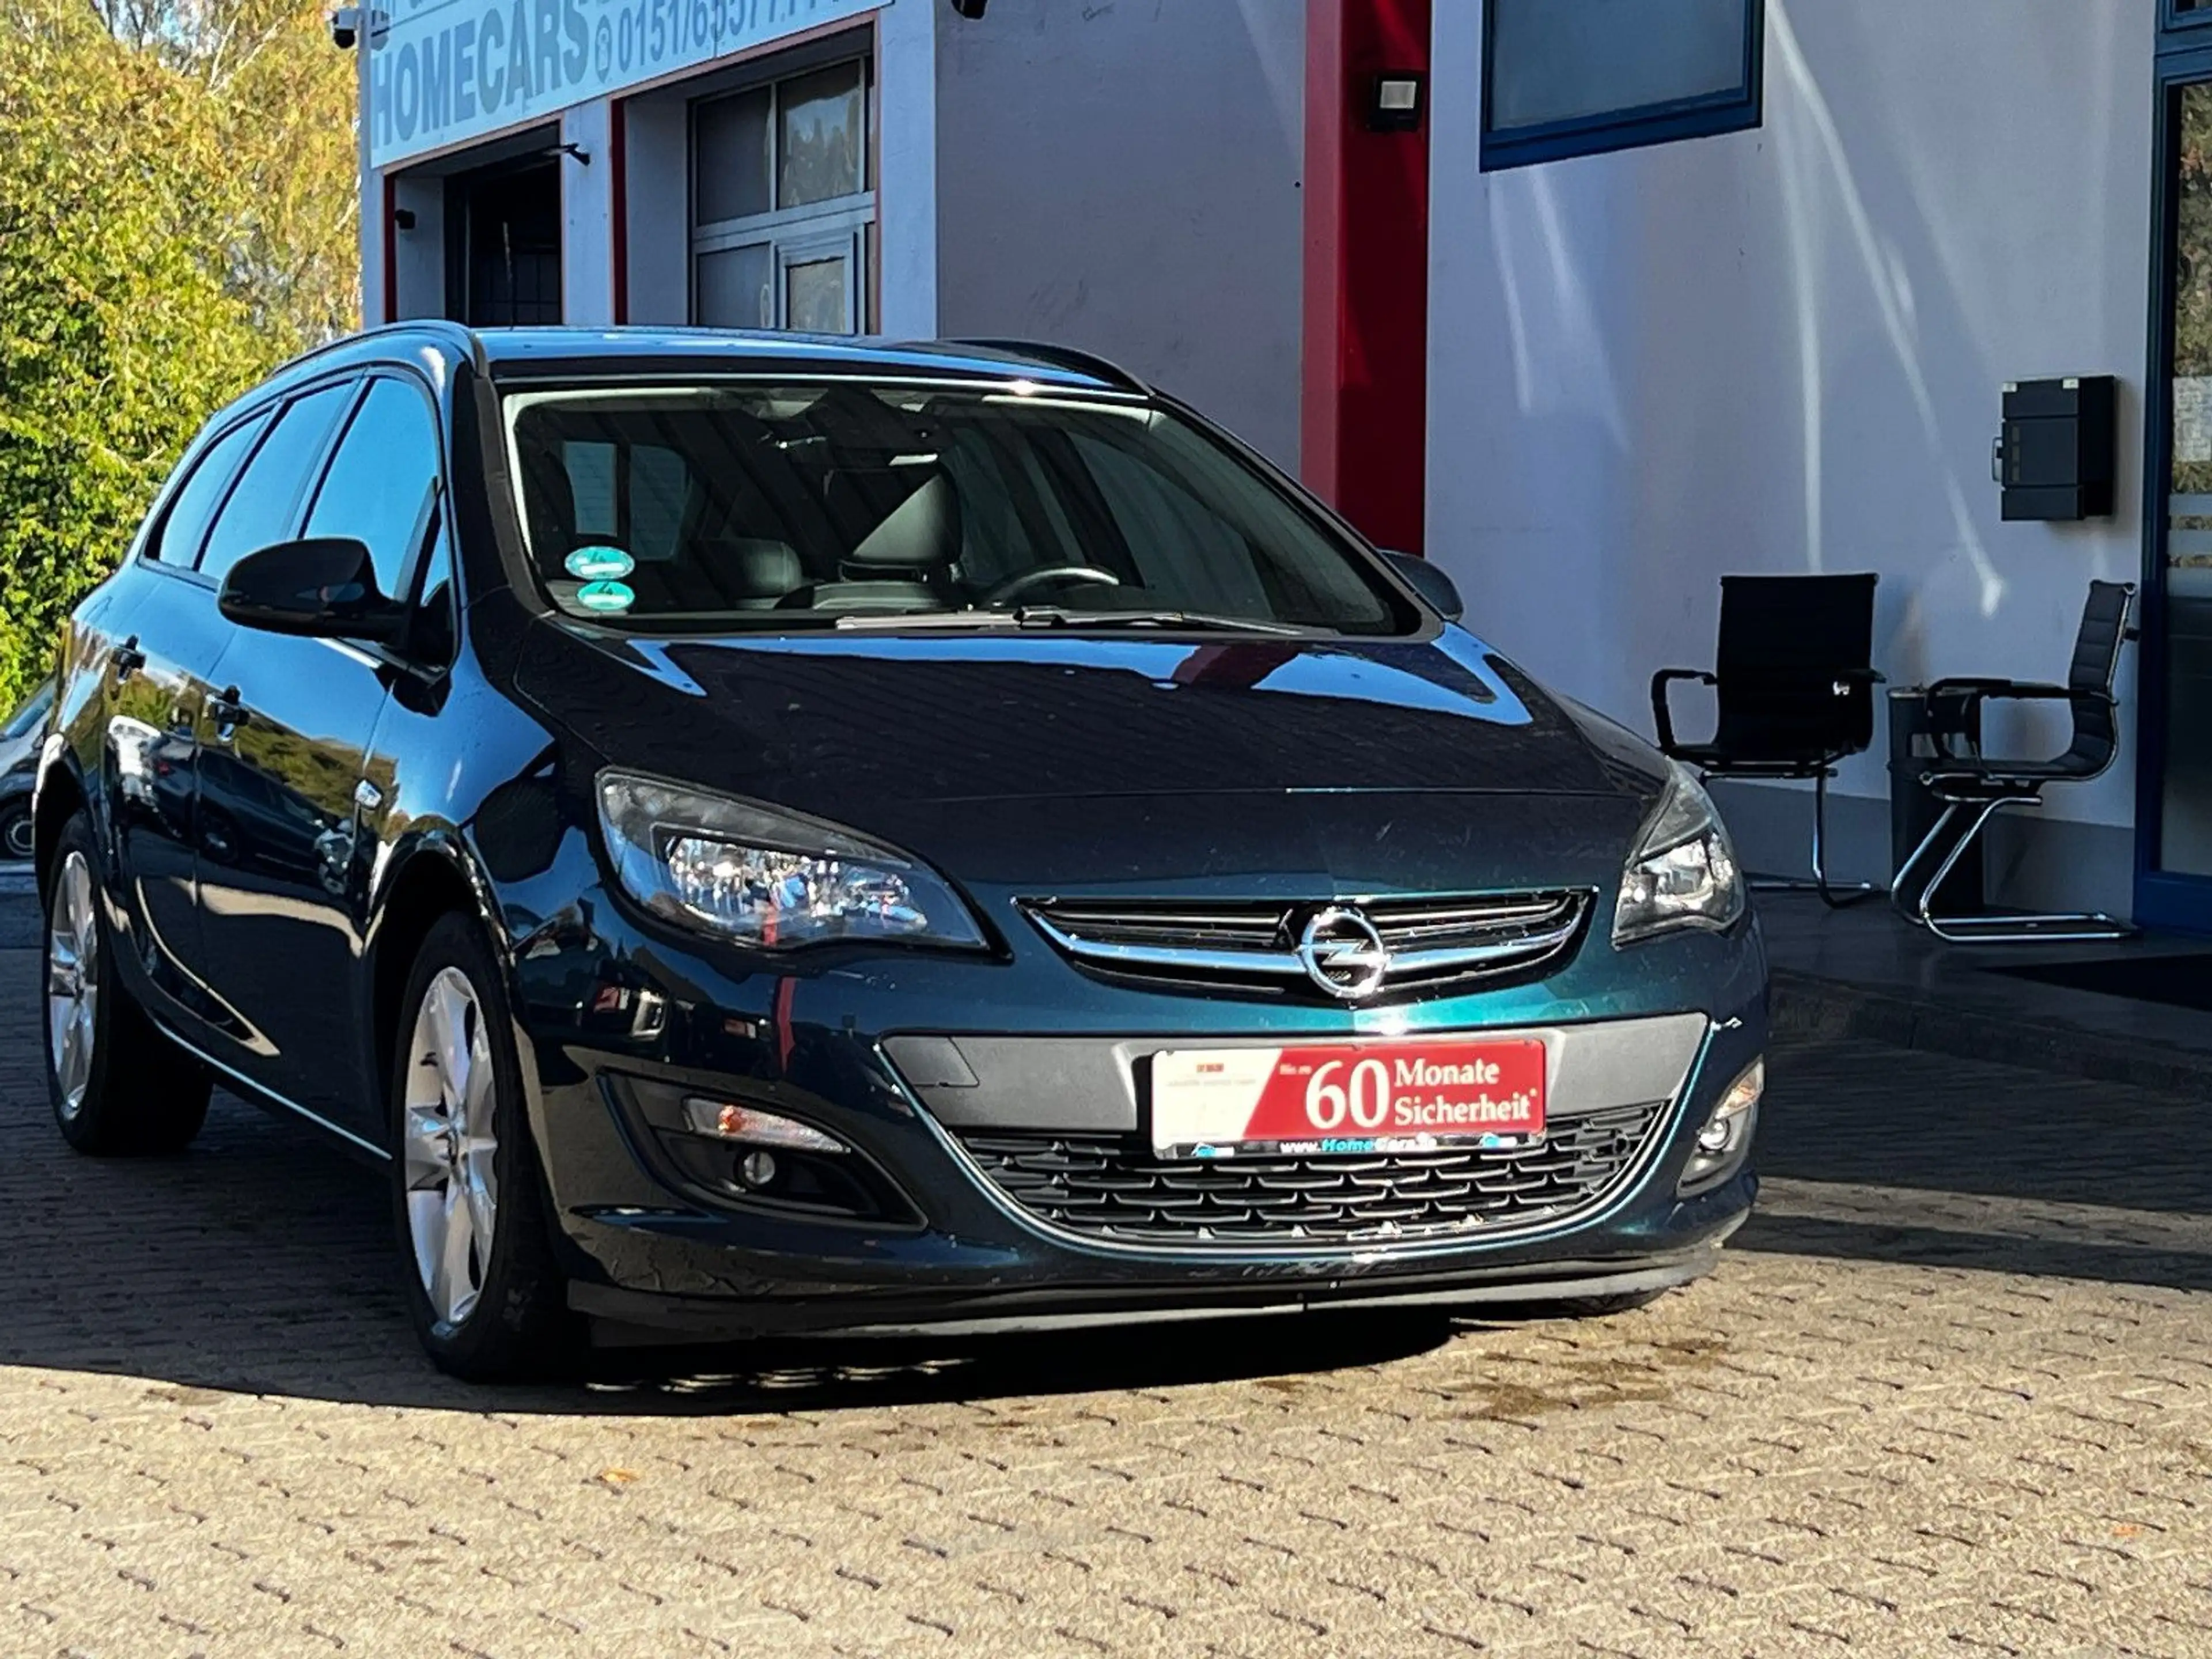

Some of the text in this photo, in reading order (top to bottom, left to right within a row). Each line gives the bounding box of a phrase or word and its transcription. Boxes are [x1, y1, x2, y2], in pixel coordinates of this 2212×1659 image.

[373, 0, 589, 149] HOMECARS
[1306, 1059, 1390, 1129] 60
[1394, 1058, 1500, 1087] Monate
[1394, 1093, 1531, 1126] Sicherheit
